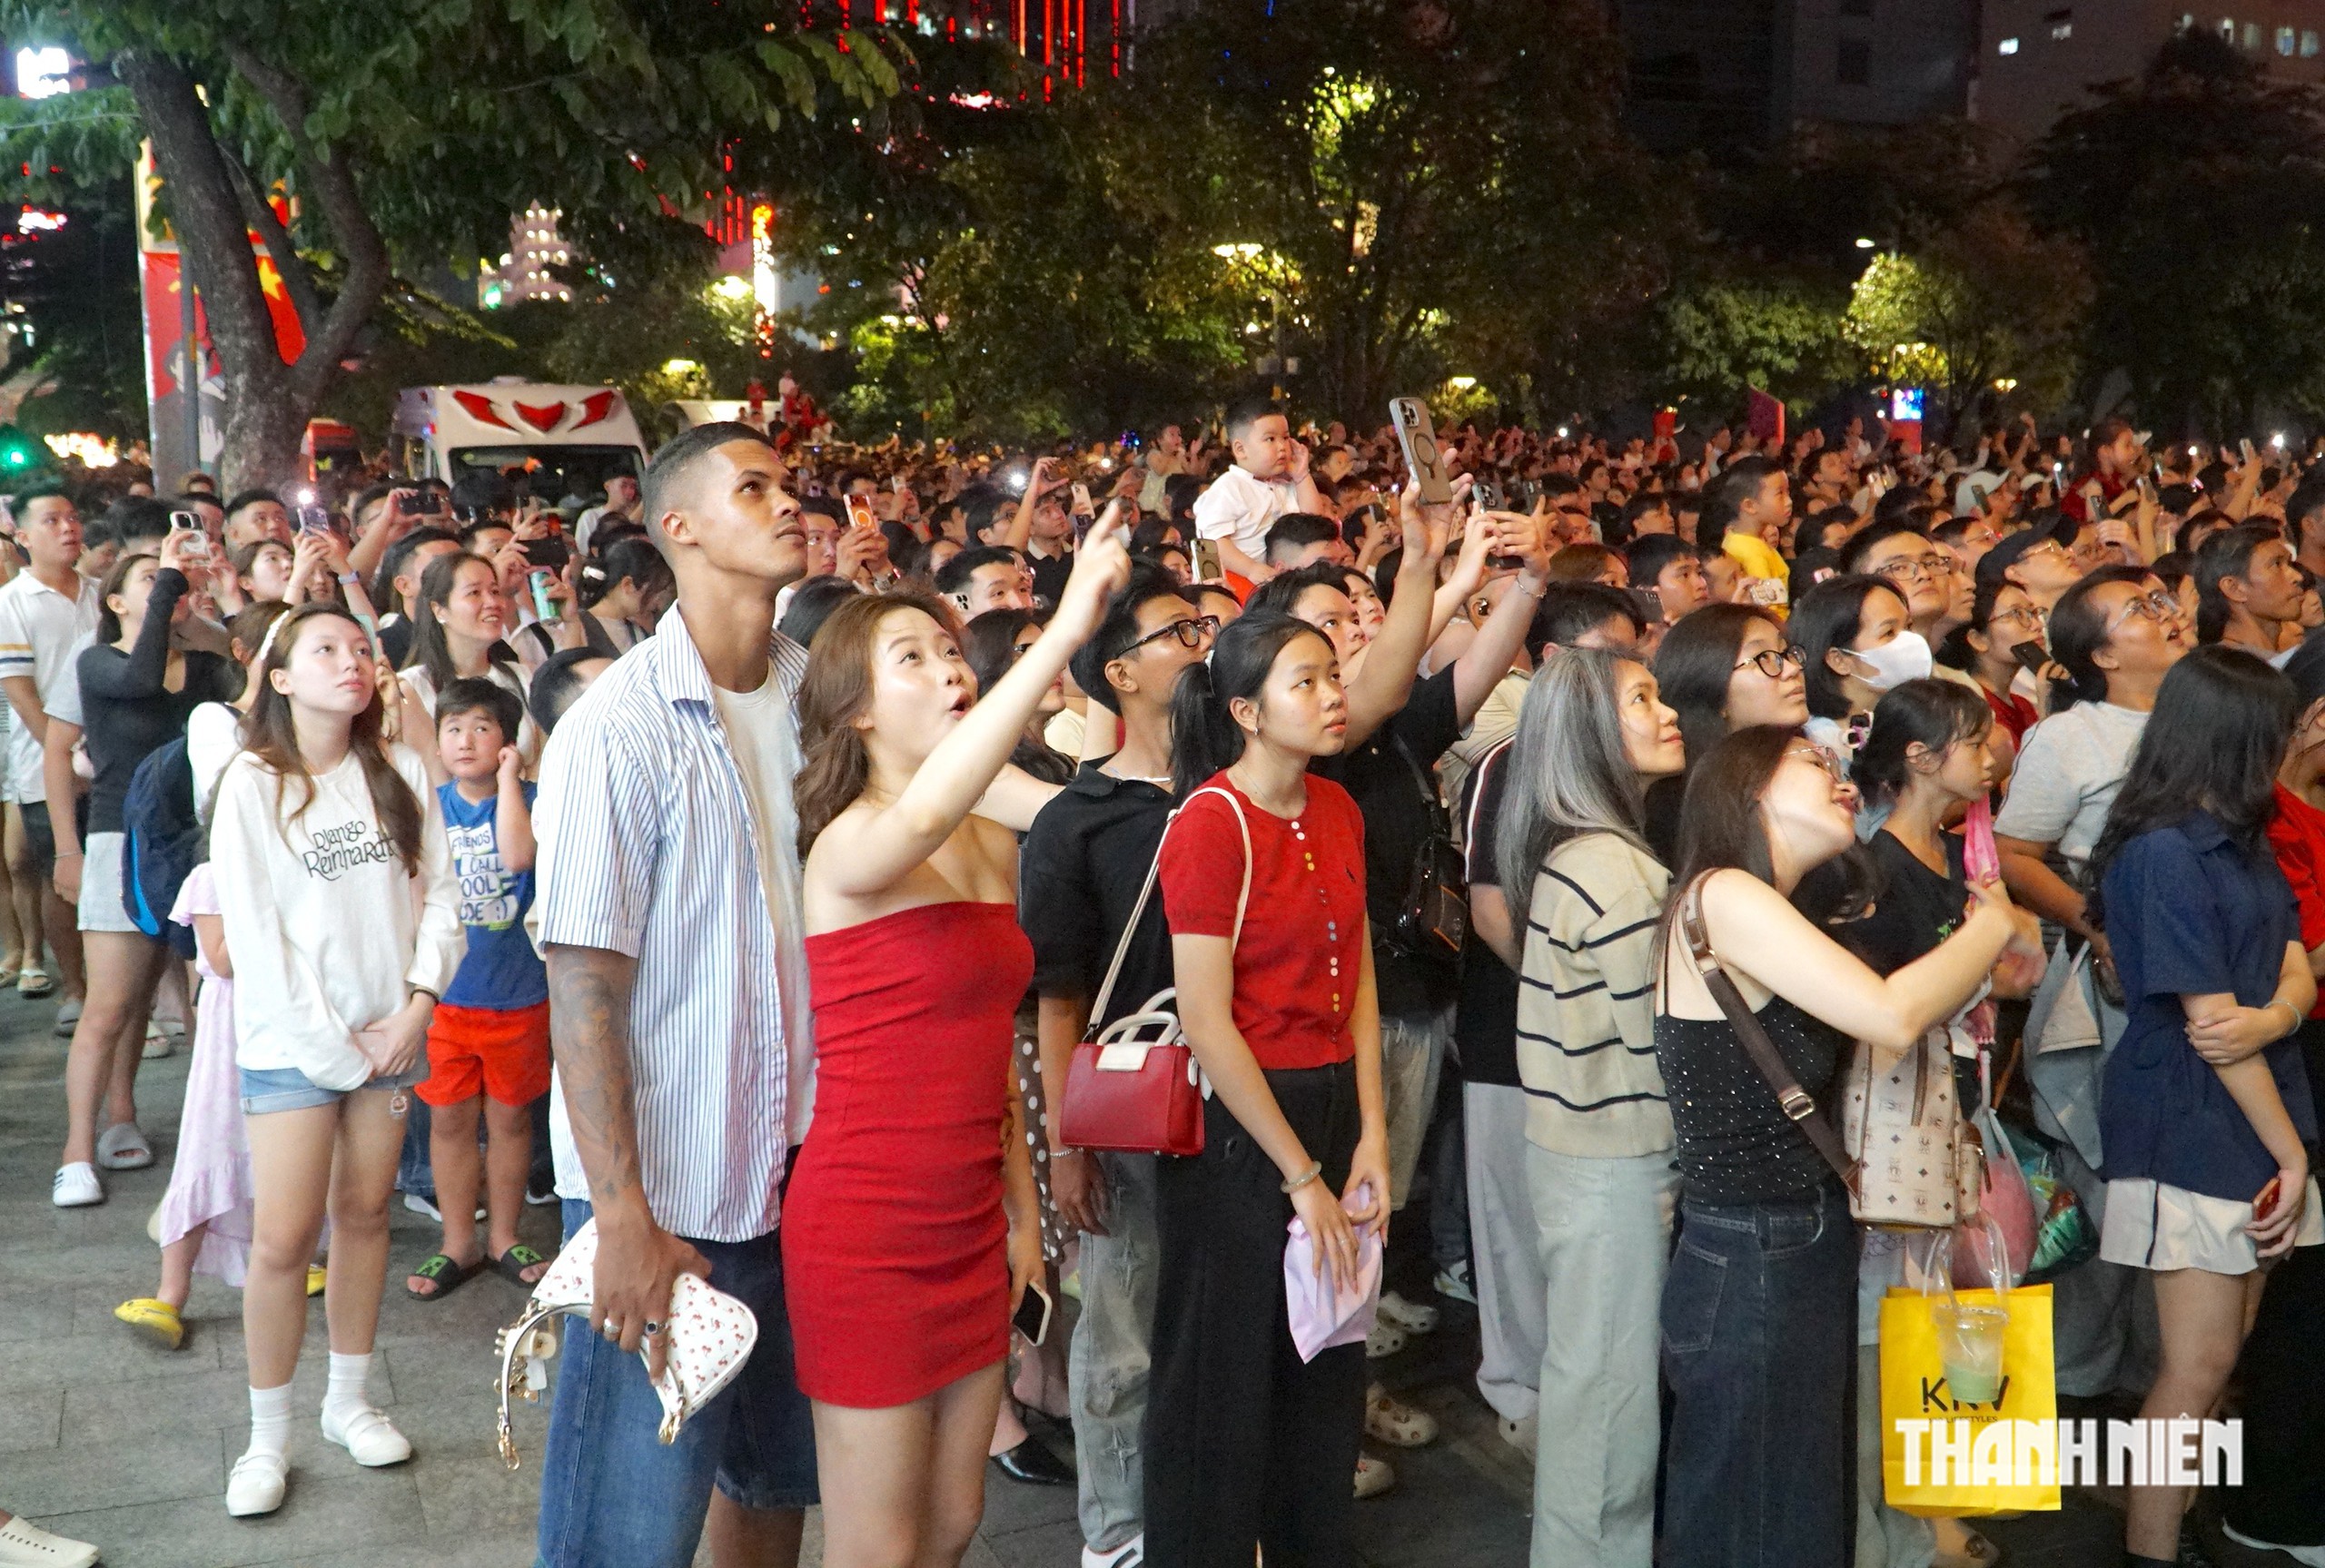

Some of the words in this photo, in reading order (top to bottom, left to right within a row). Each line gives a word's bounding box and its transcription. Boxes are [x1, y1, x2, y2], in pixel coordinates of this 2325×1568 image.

[312, 821, 367, 852] Django
[451, 830, 491, 852] FRIENDS
[461, 874, 497, 898] OOL
[1922, 1376, 2010, 1413] KV
